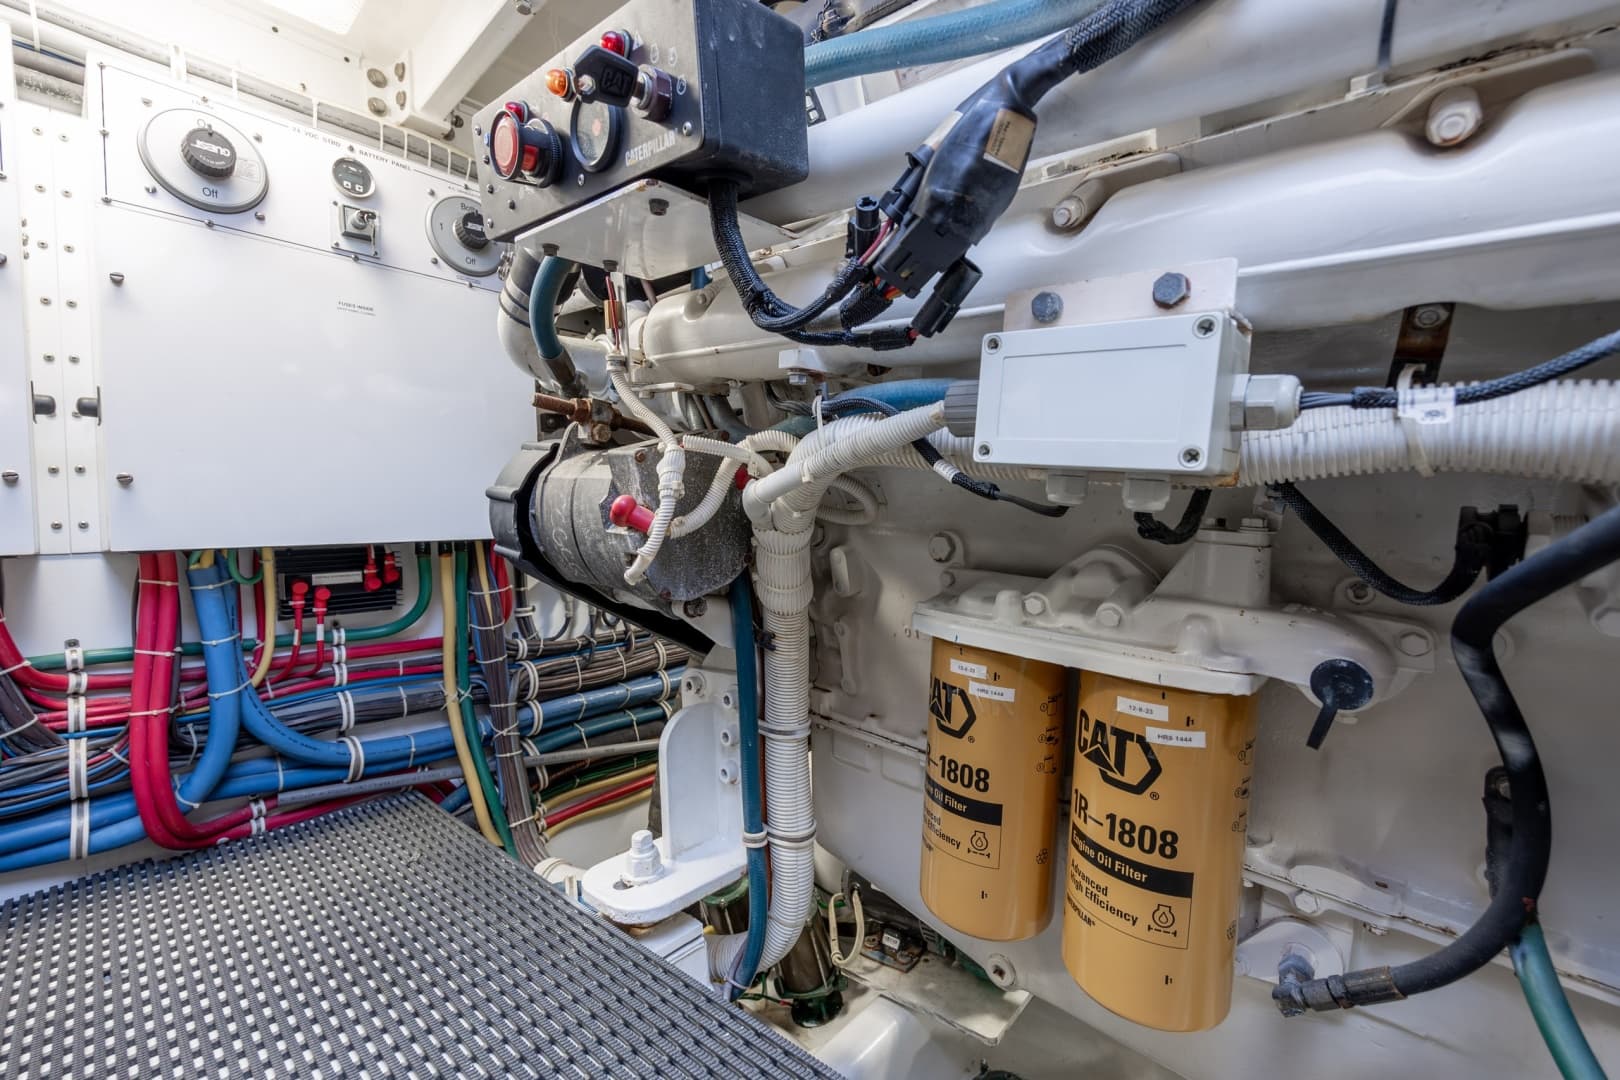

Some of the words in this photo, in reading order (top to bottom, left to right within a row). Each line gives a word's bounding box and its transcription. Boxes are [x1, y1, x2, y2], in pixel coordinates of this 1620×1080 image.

[359, 149, 388, 164] BATTERY
[391, 161, 411, 172] PANEL
[625, 130, 676, 166] CATERPILLAR
[203, 187, 218, 199] Off
[465, 256, 476, 265] Off
[1077, 708, 1134, 777] CAT
[945, 794, 968, 813] Filter
[928, 819, 961, 850] Efficiency
[1074, 788, 1179, 860] 1R-1808
[1072, 830, 1095, 859] Engine
[1097, 853, 1111, 869] Oil
[1115, 861, 1148, 884] Filter
[1071, 859, 1108, 898] Advanced
[1070, 871, 1084, 894] High
[1085, 887, 1139, 927] Efficiency
